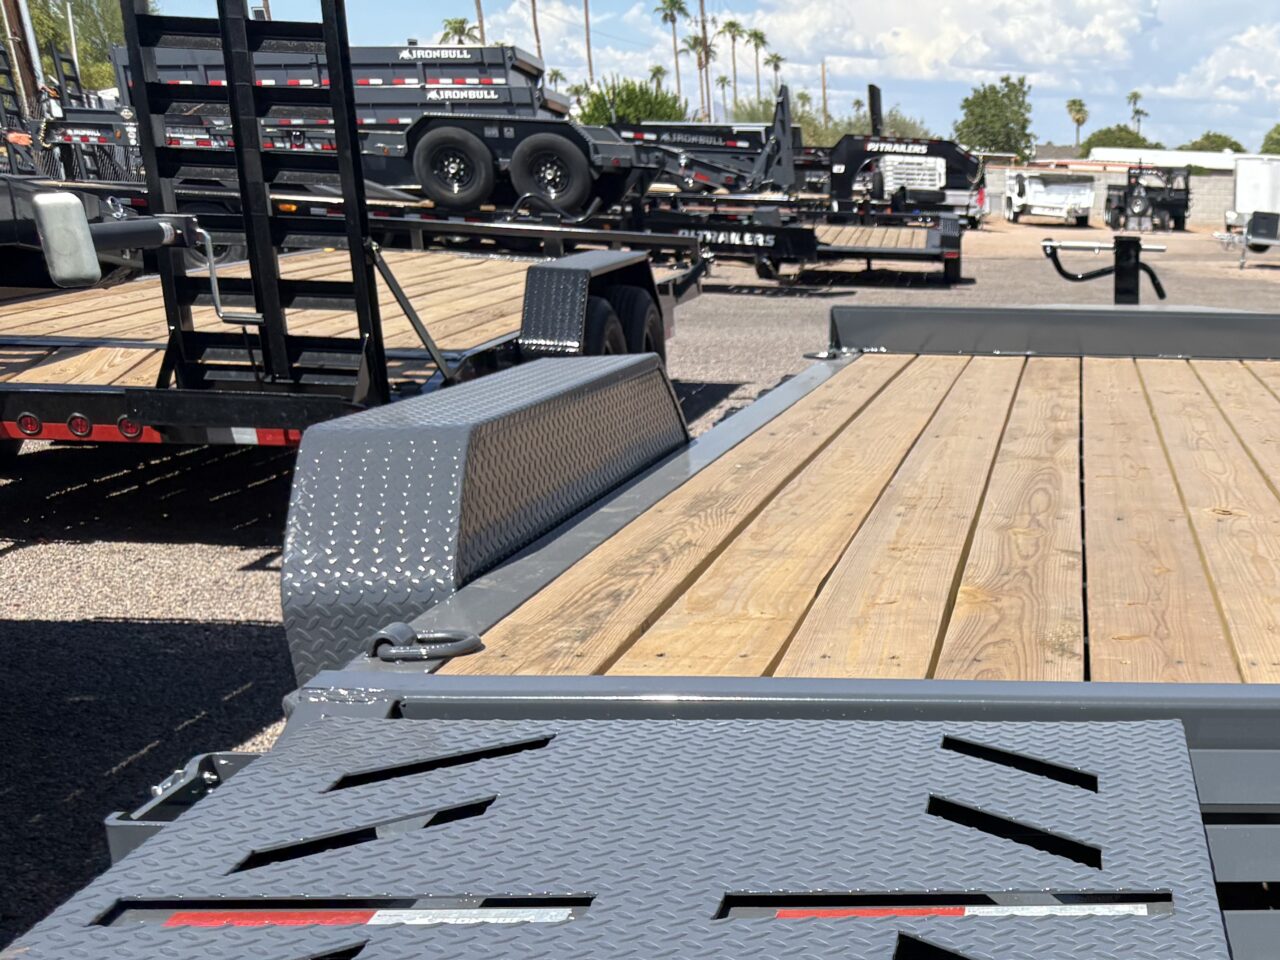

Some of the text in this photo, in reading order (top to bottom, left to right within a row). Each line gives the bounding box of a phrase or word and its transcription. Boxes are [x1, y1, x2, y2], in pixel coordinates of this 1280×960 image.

[412, 49, 471, 59] IRONBULL
[440, 90, 498, 99] IRONBULL
[671, 132, 726, 145] IRONBULL
[697, 230, 776, 247] TRAILERS
